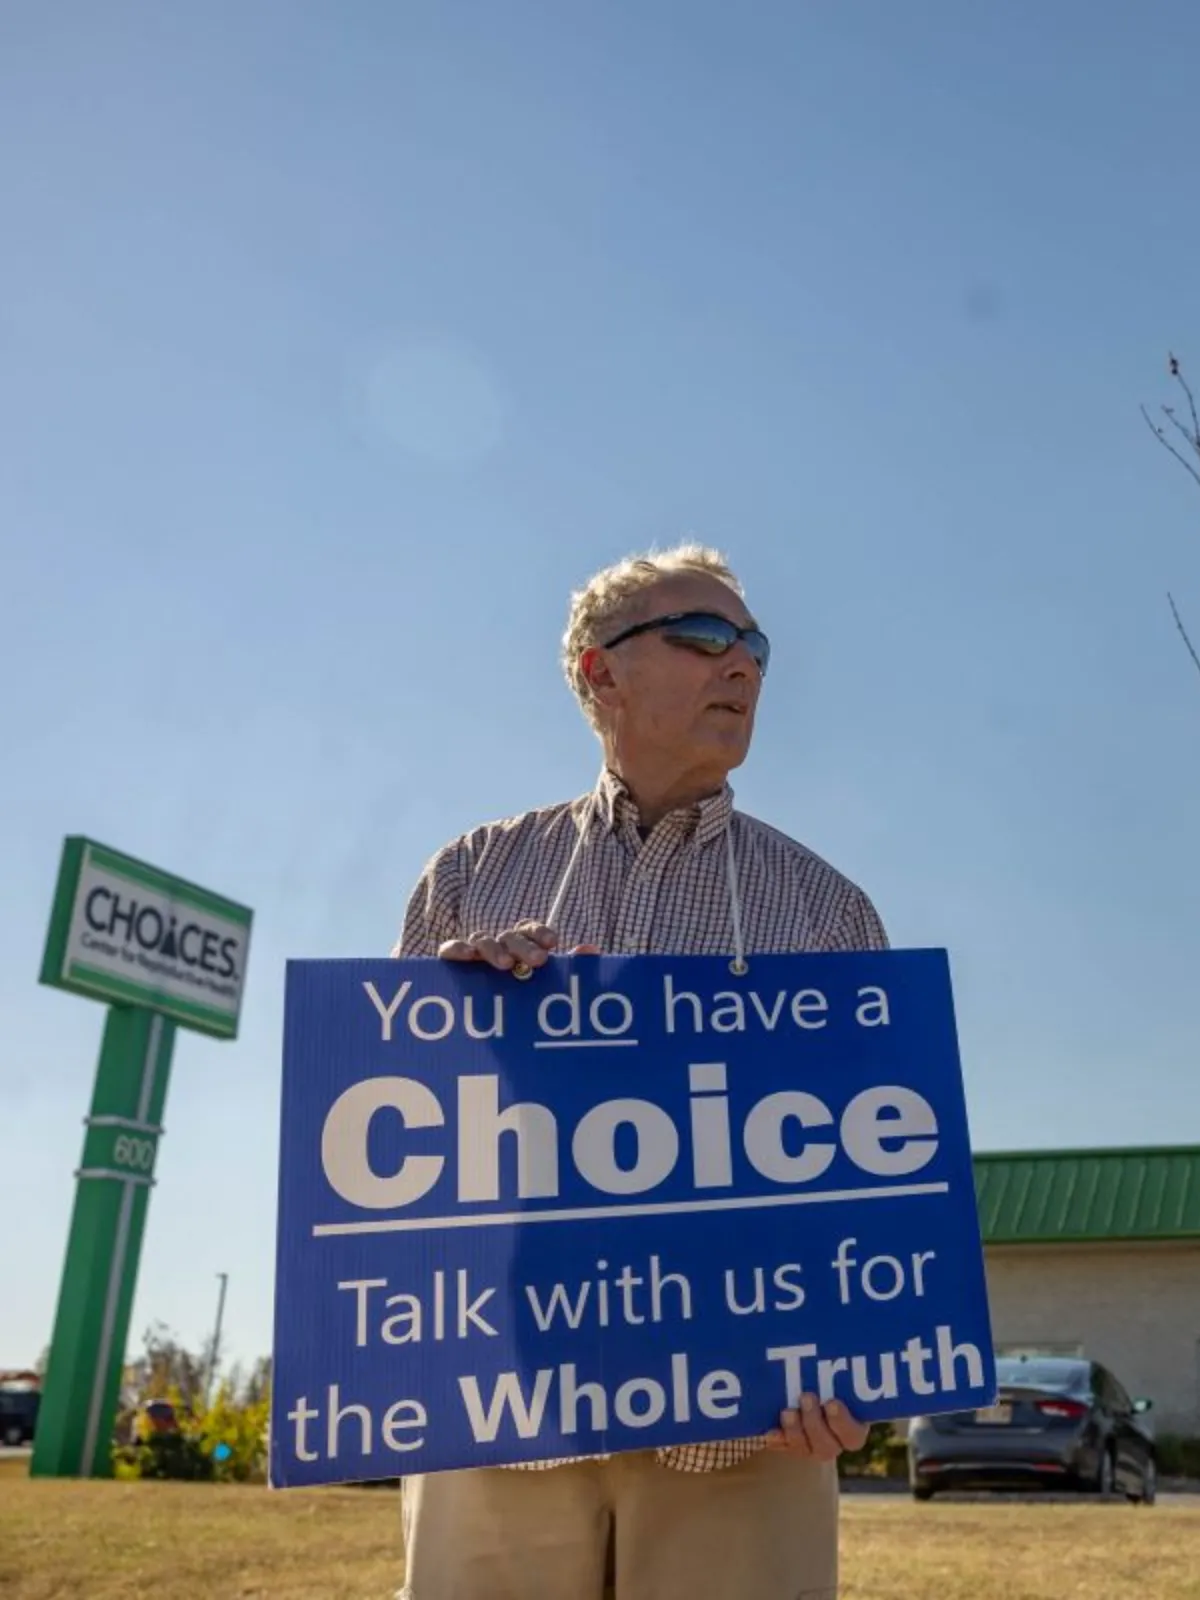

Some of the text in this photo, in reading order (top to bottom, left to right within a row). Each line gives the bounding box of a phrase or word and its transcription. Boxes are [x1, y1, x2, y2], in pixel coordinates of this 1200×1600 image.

[85, 885, 238, 978] CHOICES
[363, 974, 890, 1041] You do have a
[113, 1134, 155, 1171] 600
[320, 1063, 941, 1210] Choice
[337, 1237, 936, 1348] Talk with us for
[287, 1325, 985, 1462] the Whole Truth
